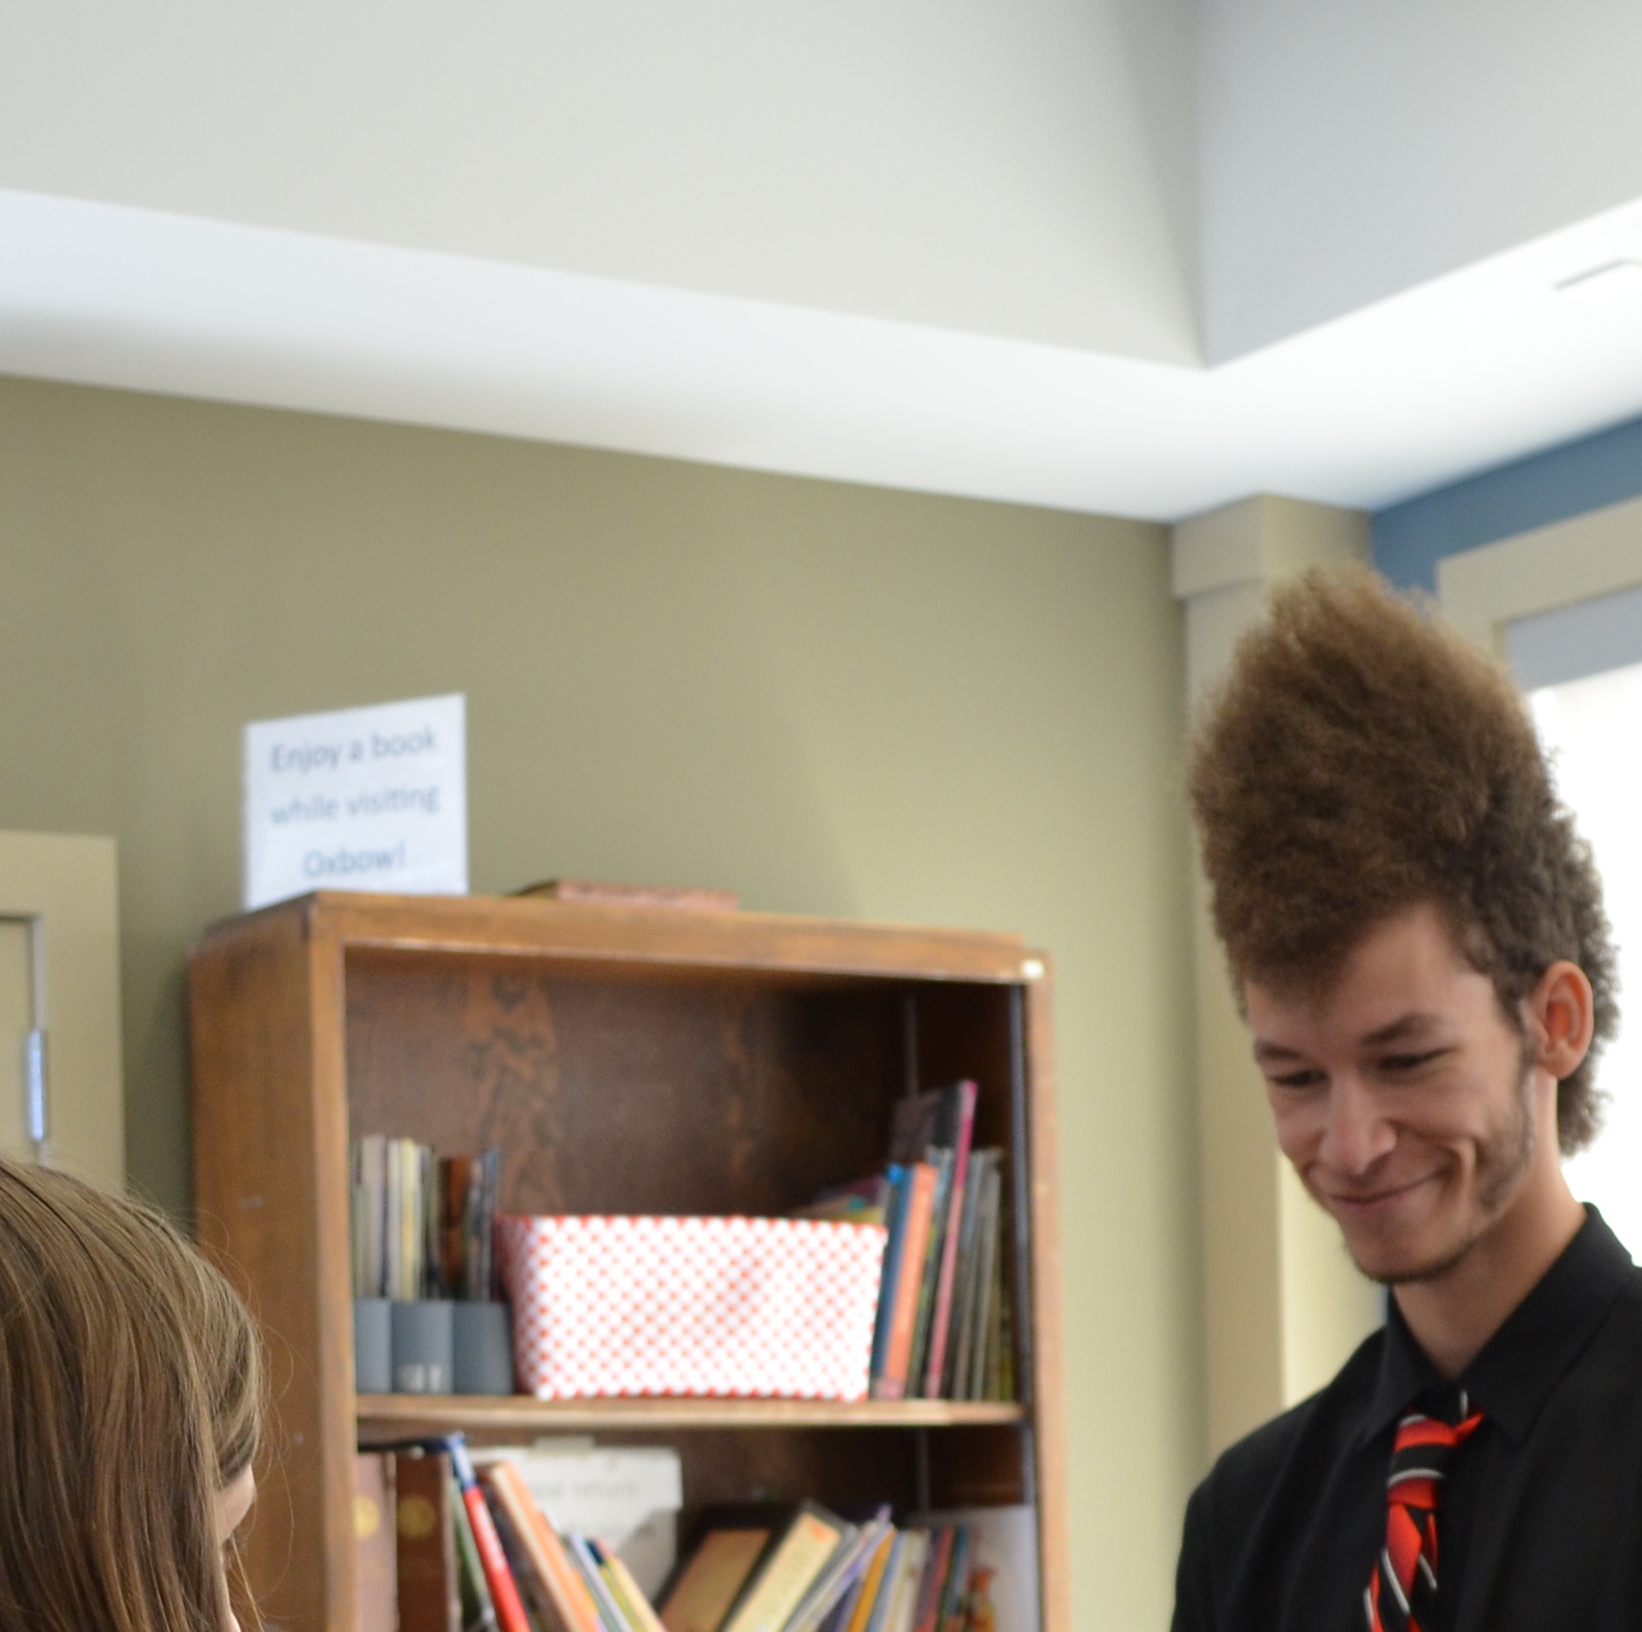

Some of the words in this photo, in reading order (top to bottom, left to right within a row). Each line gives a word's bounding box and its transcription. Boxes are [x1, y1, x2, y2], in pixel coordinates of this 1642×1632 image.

[271, 743, 342, 774] Enjoy
[349, 741, 364, 763] a
[372, 725, 437, 759] book
[271, 795, 339, 823] while
[348, 785, 441, 815] visiting
[304, 842, 407, 877] Oxbow!
